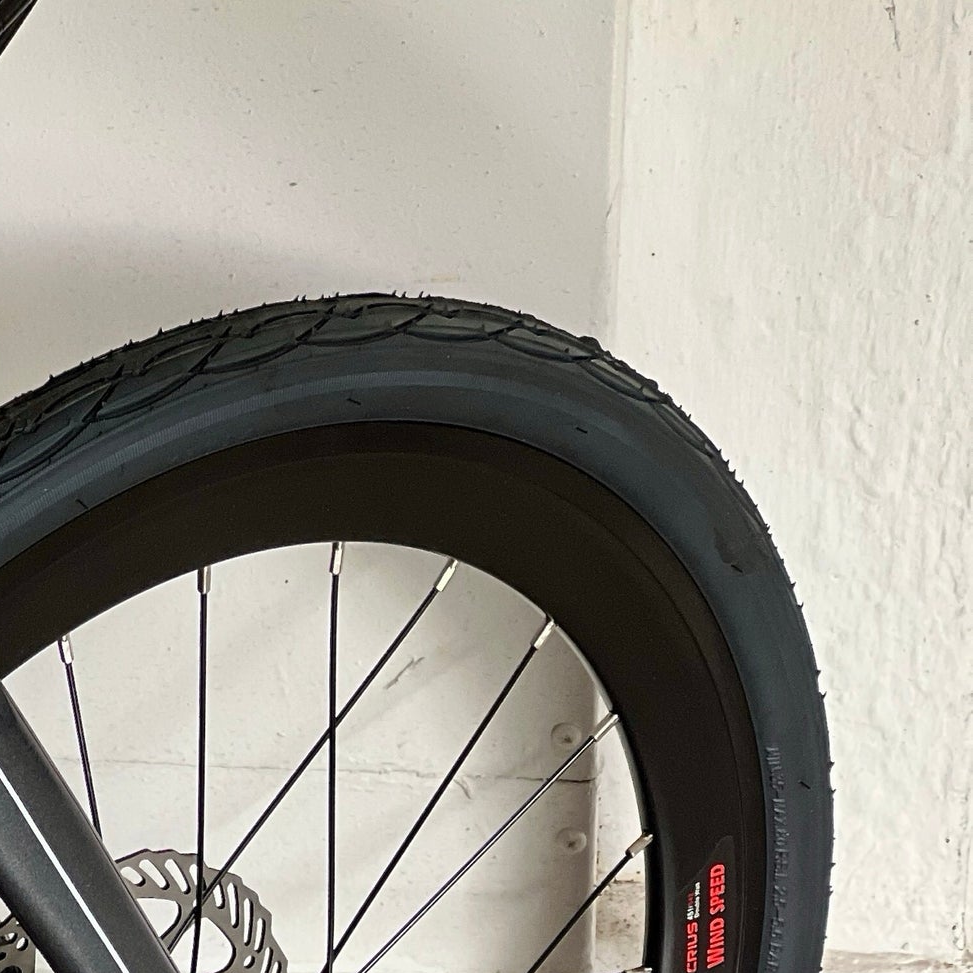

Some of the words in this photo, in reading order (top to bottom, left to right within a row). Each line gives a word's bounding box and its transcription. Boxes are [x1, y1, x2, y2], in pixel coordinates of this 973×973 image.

[710, 864, 725, 915] SPEED
[685, 921, 699, 973] CRIUS
[707, 917, 725, 969] WIND
